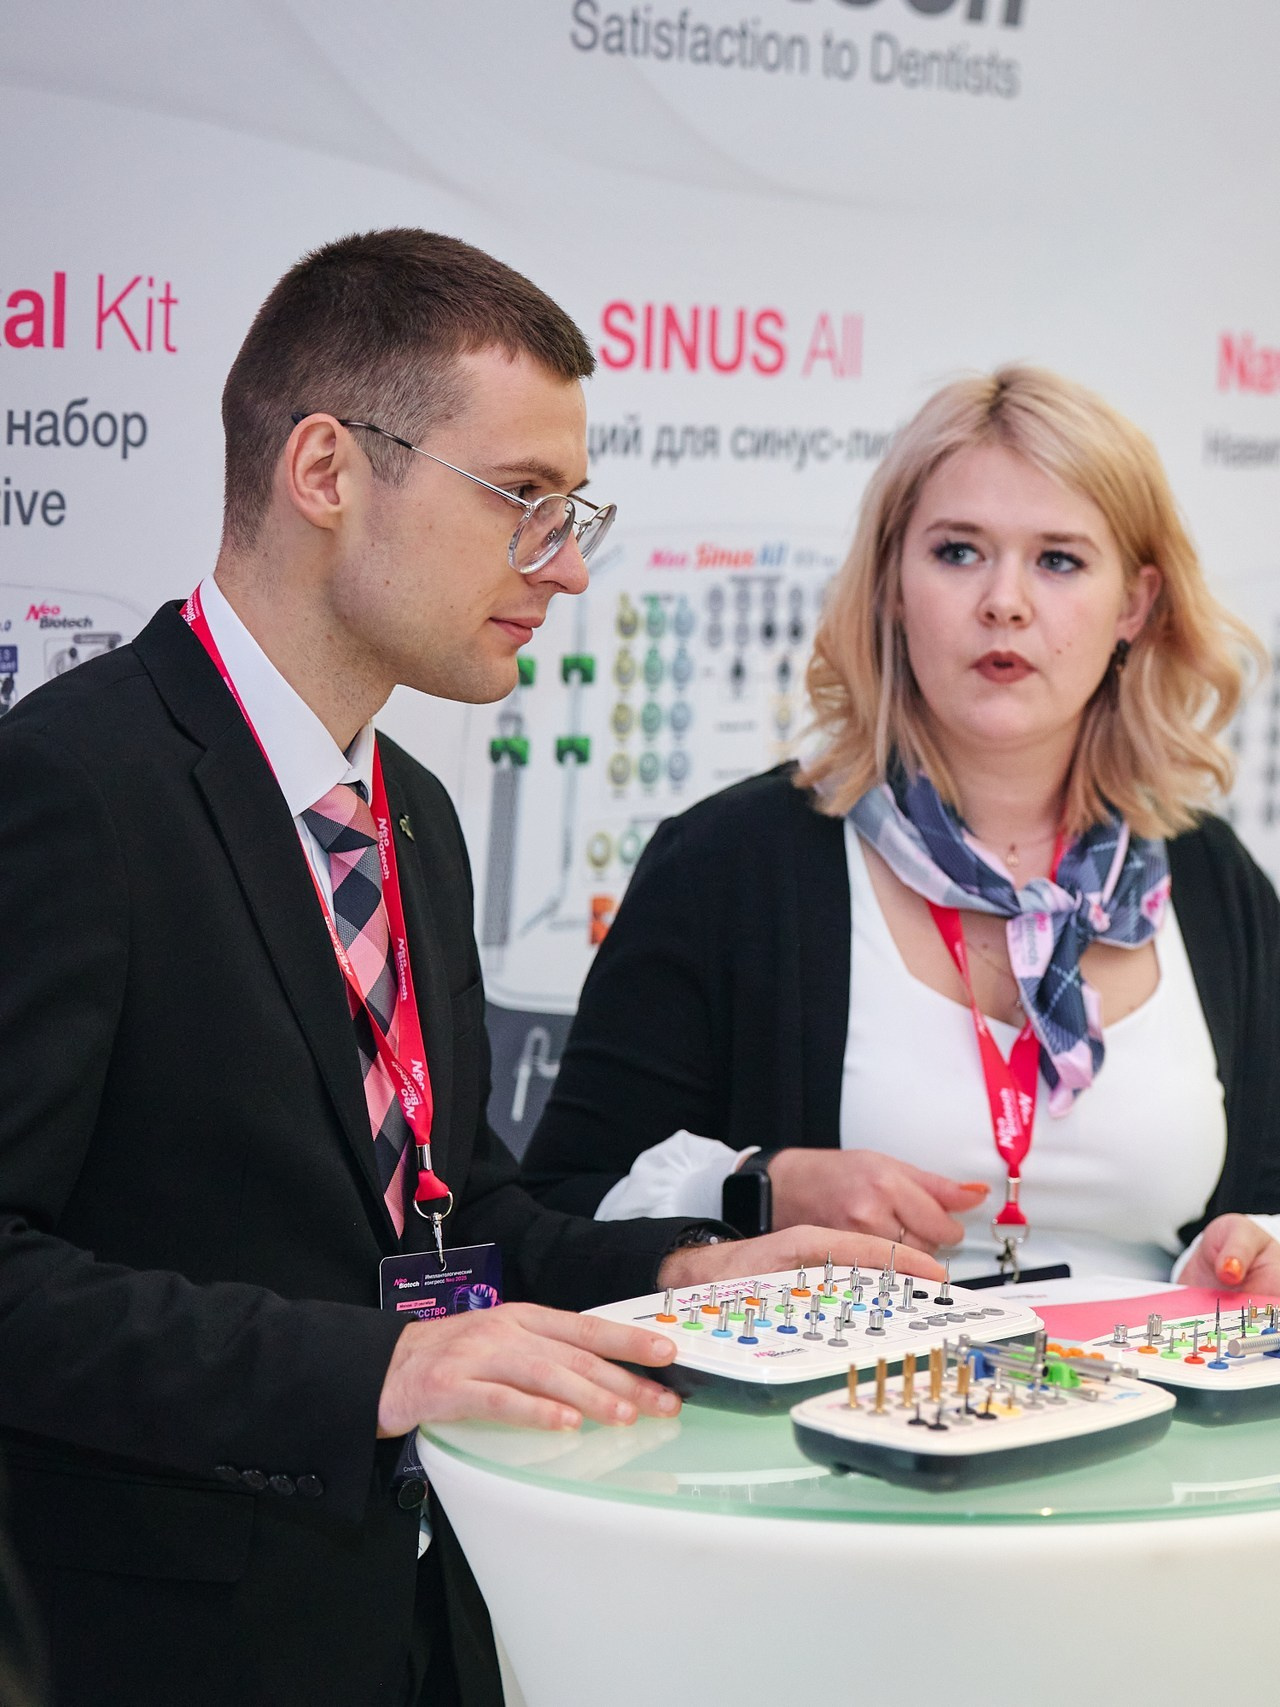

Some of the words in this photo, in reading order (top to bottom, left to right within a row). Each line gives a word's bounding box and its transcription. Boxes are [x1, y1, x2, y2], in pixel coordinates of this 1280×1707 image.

[570, 0, 810, 78] Satisfaction
[822, 31, 860, 82] to
[869, 33, 1021, 99] Dentists
[0, 270, 66, 350] al
[96, 272, 179, 353] Kit
[599, 299, 788, 378] SINUS
[800, 312, 864, 380] All
[6, 397, 148, 460] набор
[651, 424, 721, 470] для
[729, 426, 890, 473] синус-ли
[0, 477, 66, 527] ive
[25, 604, 61, 622] Neo
[39, 616, 93, 630] Biotech
[377, 817, 390, 848] Neo
[377, 831, 390, 881] Biotech
[391, 1061, 420, 1106] Biotech
[401, 1088, 416, 1120] Neo
[398, 1281, 420, 1290] Biotech
